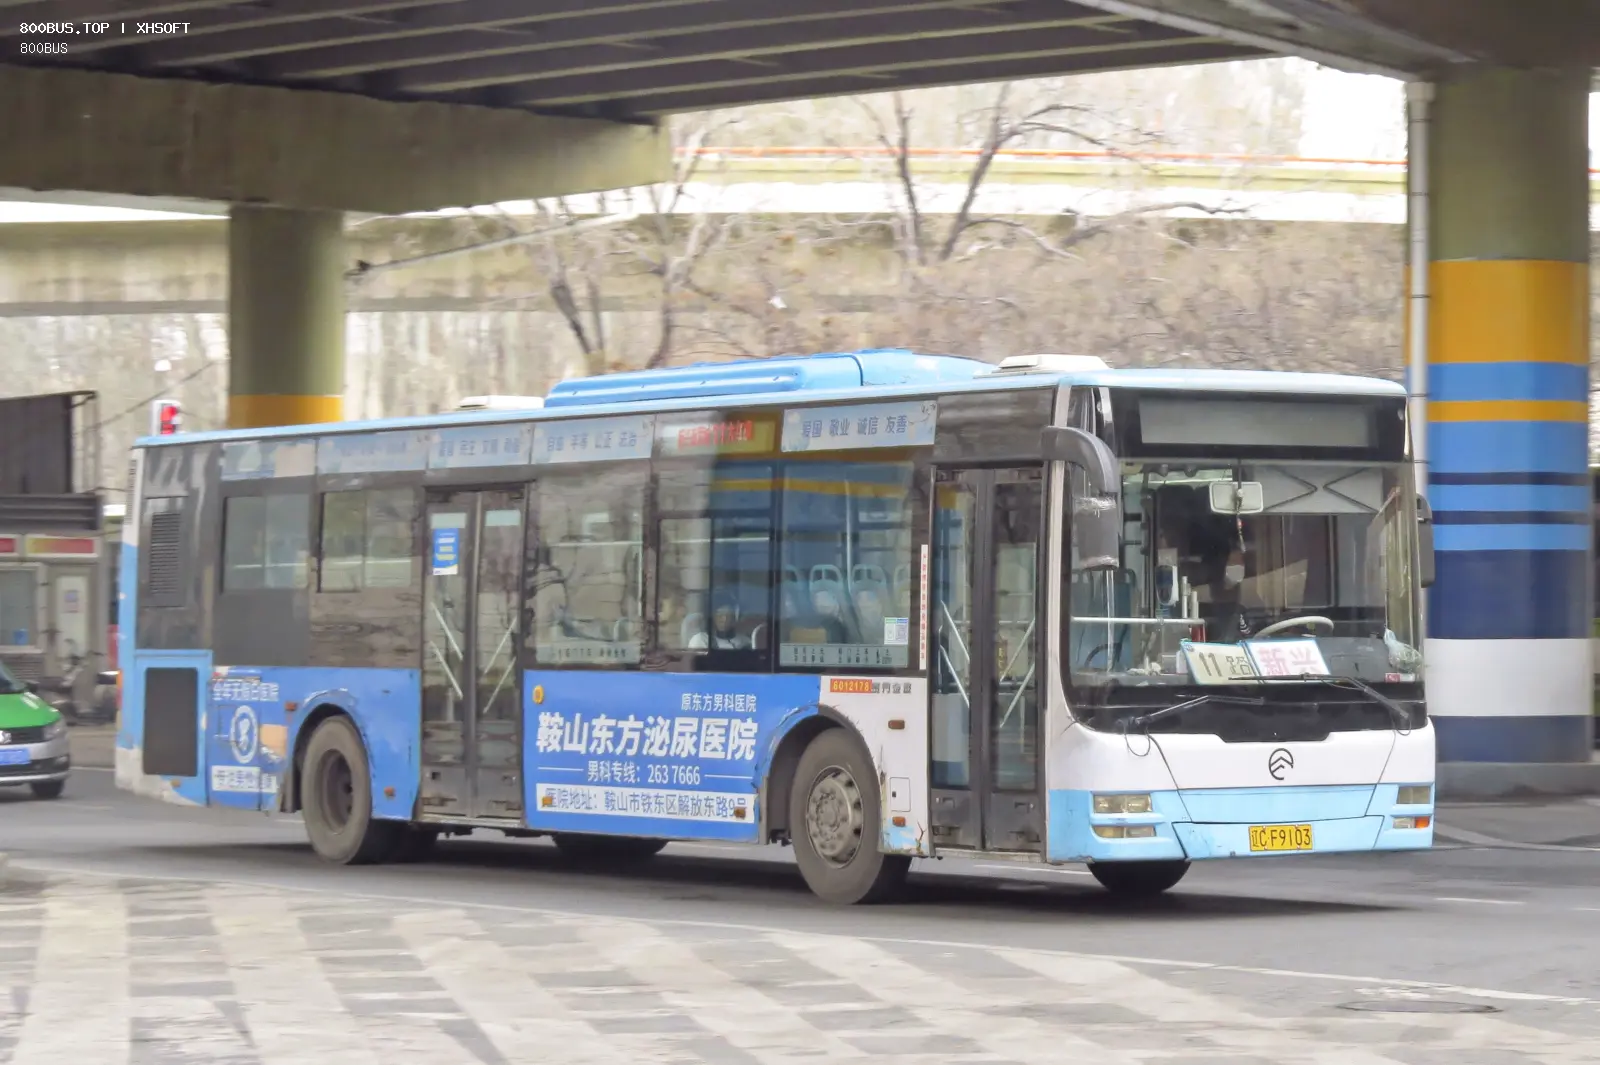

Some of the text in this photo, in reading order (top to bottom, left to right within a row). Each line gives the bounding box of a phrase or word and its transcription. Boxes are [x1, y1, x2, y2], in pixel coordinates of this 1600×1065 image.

[885, 414, 908, 434] 友善
[681, 693, 757, 712] 原东方男科医院
[536, 712, 758, 760] 鞍山东方泌尿医院
